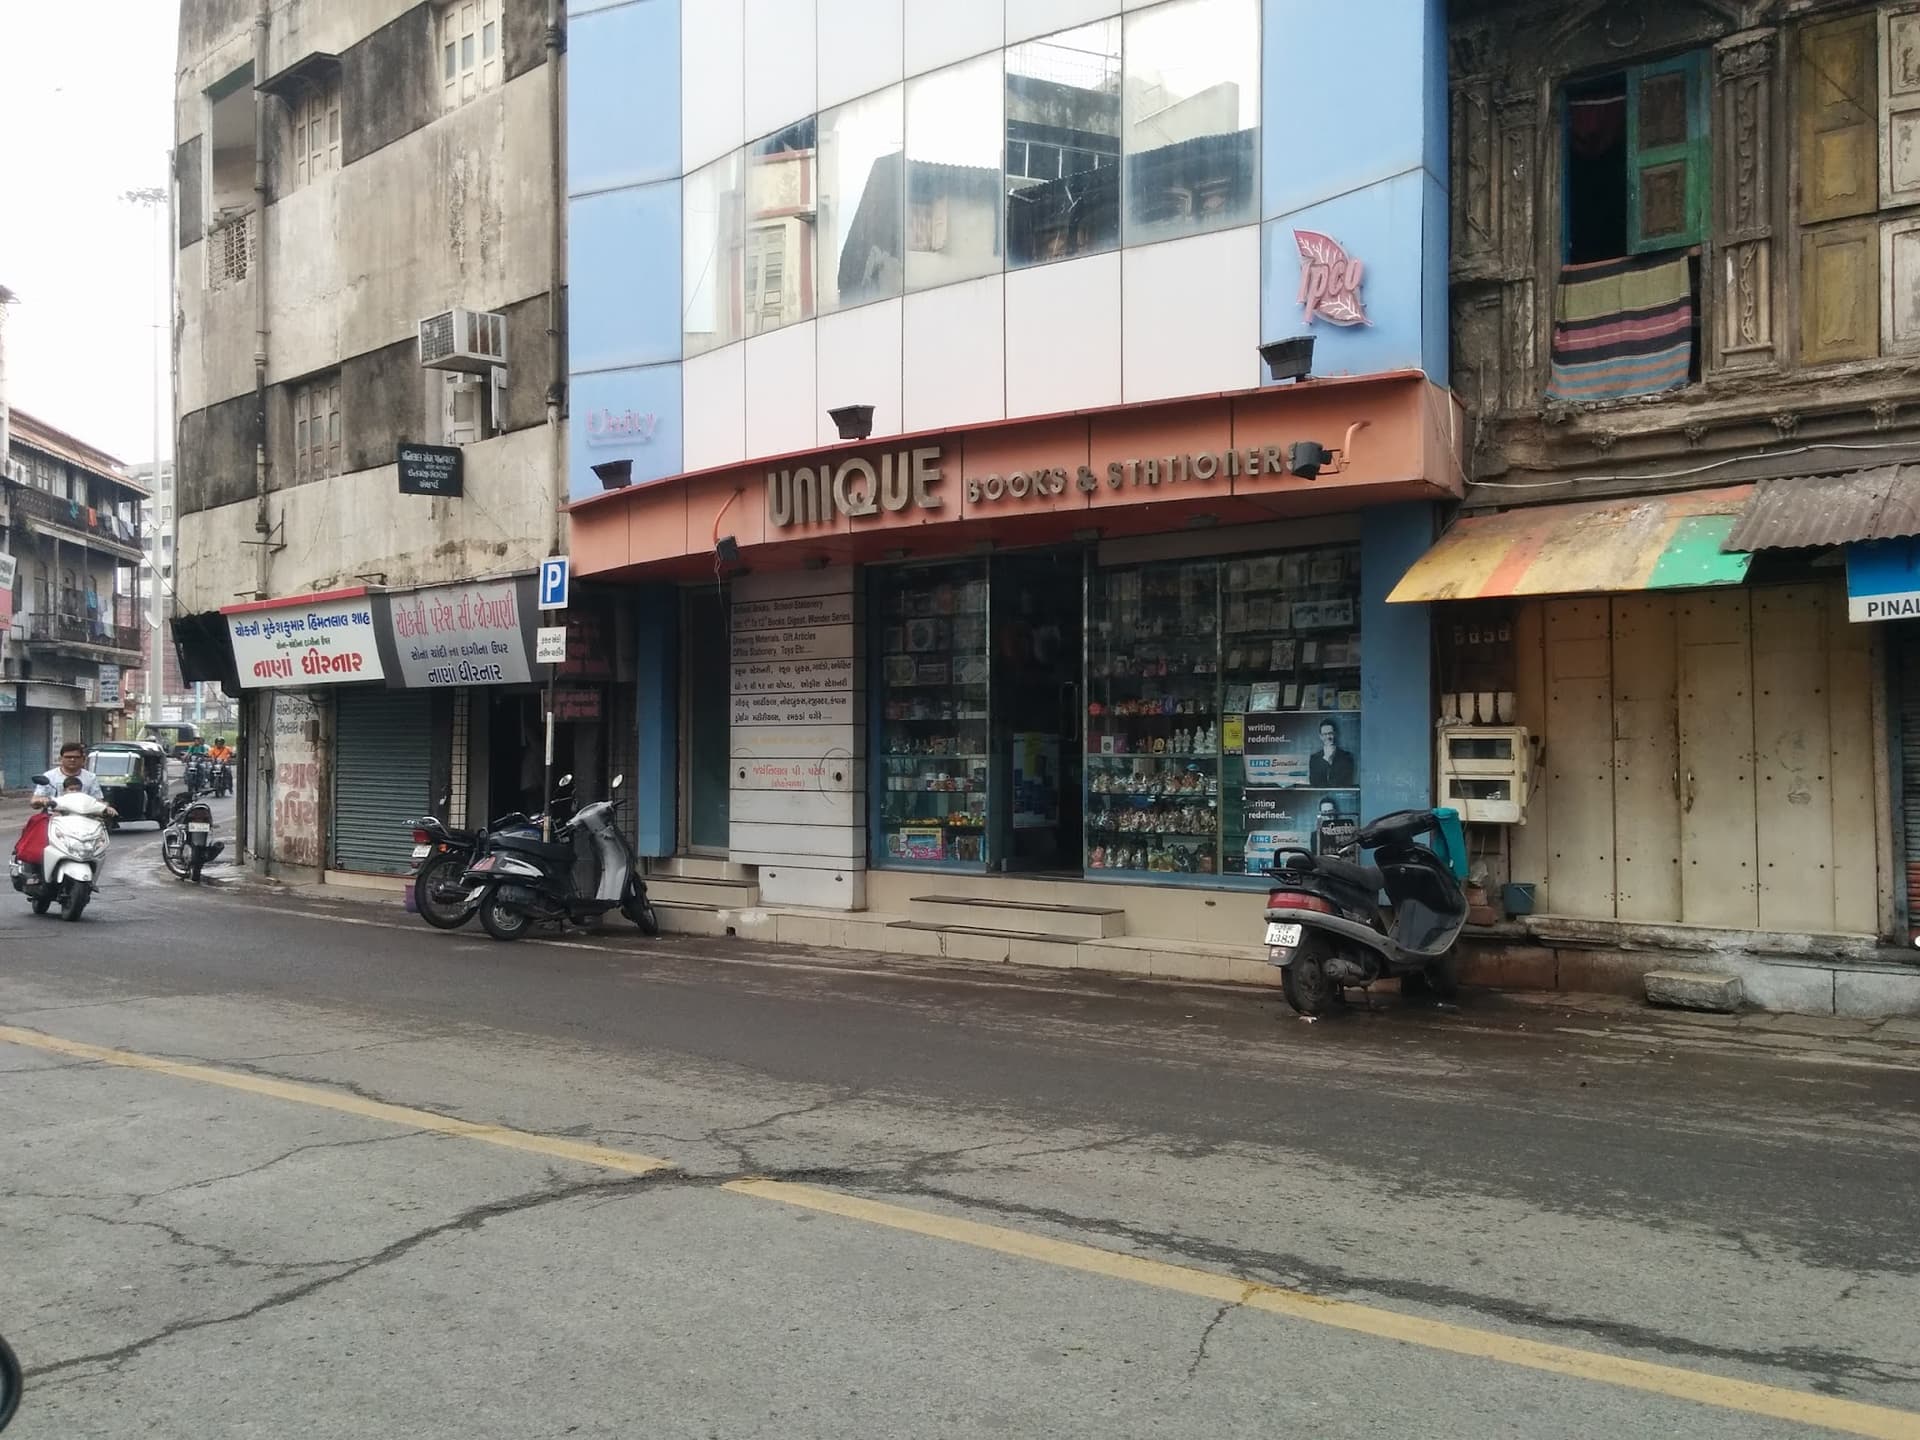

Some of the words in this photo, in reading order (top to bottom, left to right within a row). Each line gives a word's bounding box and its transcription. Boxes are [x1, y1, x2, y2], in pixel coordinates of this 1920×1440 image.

[767, 445, 944, 528] UNIQUE
[966, 466, 1066, 504] BOOKS
[1075, 465, 1098, 492] &
[546, 563, 562, 603] P
[263, 617, 306, 640] મુકેશકુમાર
[307, 613, 349, 631] હિંમતલાલ
[351, 611, 371, 626] શાહ
[430, 597, 456, 634] પરેશ
[783, 632, 793, 642] Gift
[794, 631, 816, 641] Articles
[411, 646, 429, 661] સોના
[430, 644, 448, 660] ચાંદી
[460, 644, 489, 657] દાગીના
[490, 640, 510, 654] ઉપર
[781, 645, 794, 656] Toys
[253, 652, 294, 679] નાણાં
[301, 647, 363, 676] ધીરનાર
[428, 664, 456, 684] નાણાં
[458, 660, 503, 684] ધીરનાર
[1247, 723, 1276, 733] writing
[1250, 759, 1269, 768] LINC
[1252, 835, 1270, 843] LINC
[1269, 933, 1295, 945] 1383
